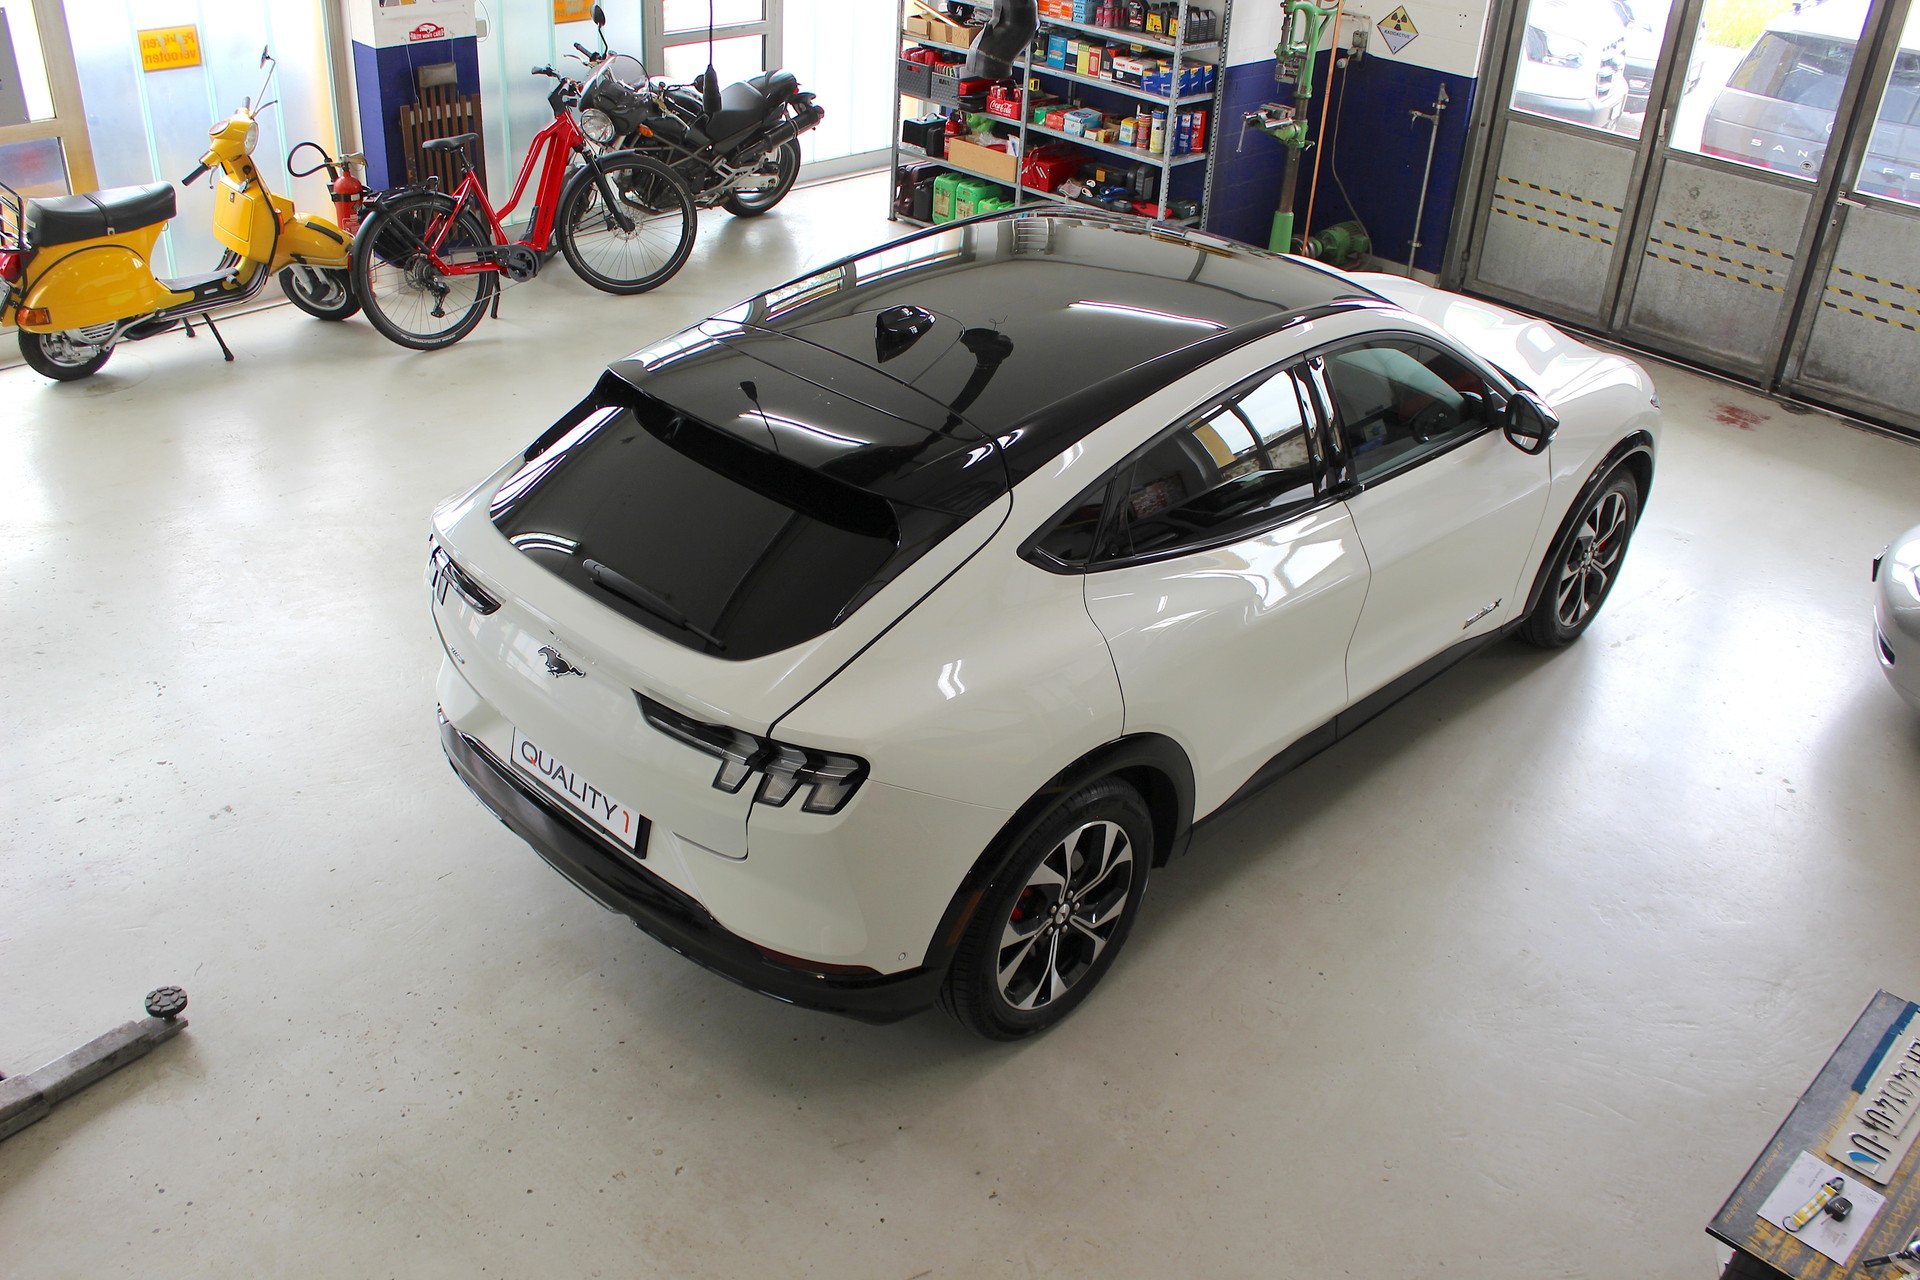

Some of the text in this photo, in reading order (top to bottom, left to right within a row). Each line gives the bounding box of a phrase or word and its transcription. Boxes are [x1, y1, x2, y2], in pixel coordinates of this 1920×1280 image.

[1383, 29, 1411, 39] RADIOACTIVE
[1750, 138, 1825, 159] SAN
[521, 740, 630, 834] QUALITY 1
